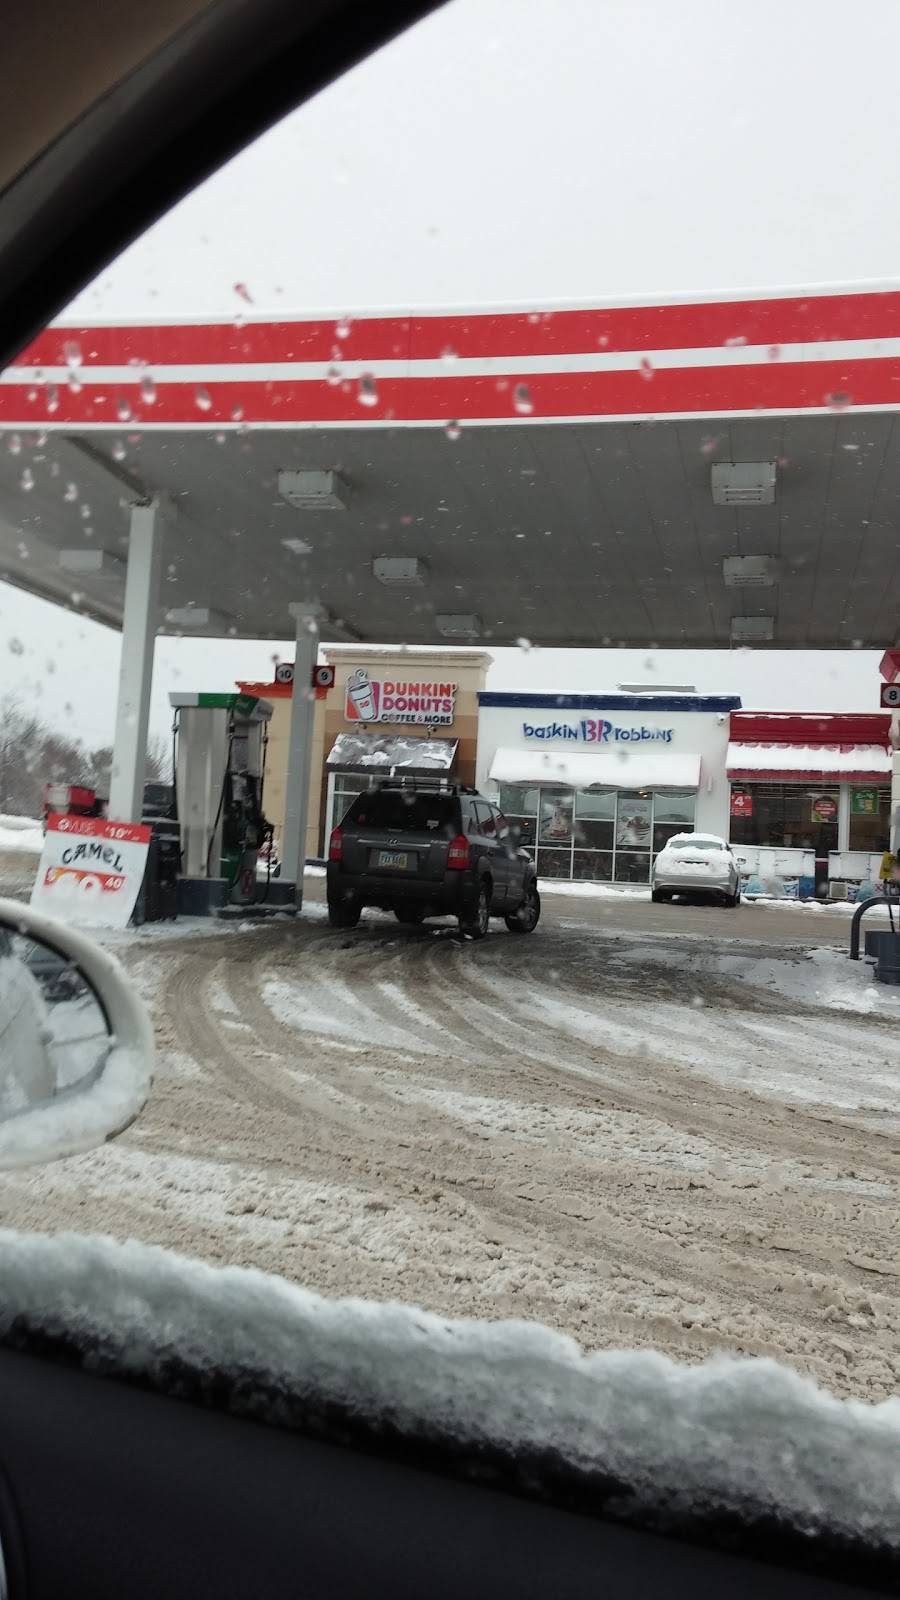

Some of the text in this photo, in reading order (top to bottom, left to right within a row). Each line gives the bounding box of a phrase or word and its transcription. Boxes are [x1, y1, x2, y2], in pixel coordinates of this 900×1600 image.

[280, 670, 292, 679] 10
[383, 682, 456, 697] DUNKIN'
[889, 690, 897, 700] 8
[382, 697, 452, 712] DONUTS
[381, 713, 416, 722] COFFEE
[424, 715, 451, 723] MORE
[523, 722, 578, 740] baskin
[615, 726, 673, 743] robbins
[62, 842, 123, 872] CAMEL
